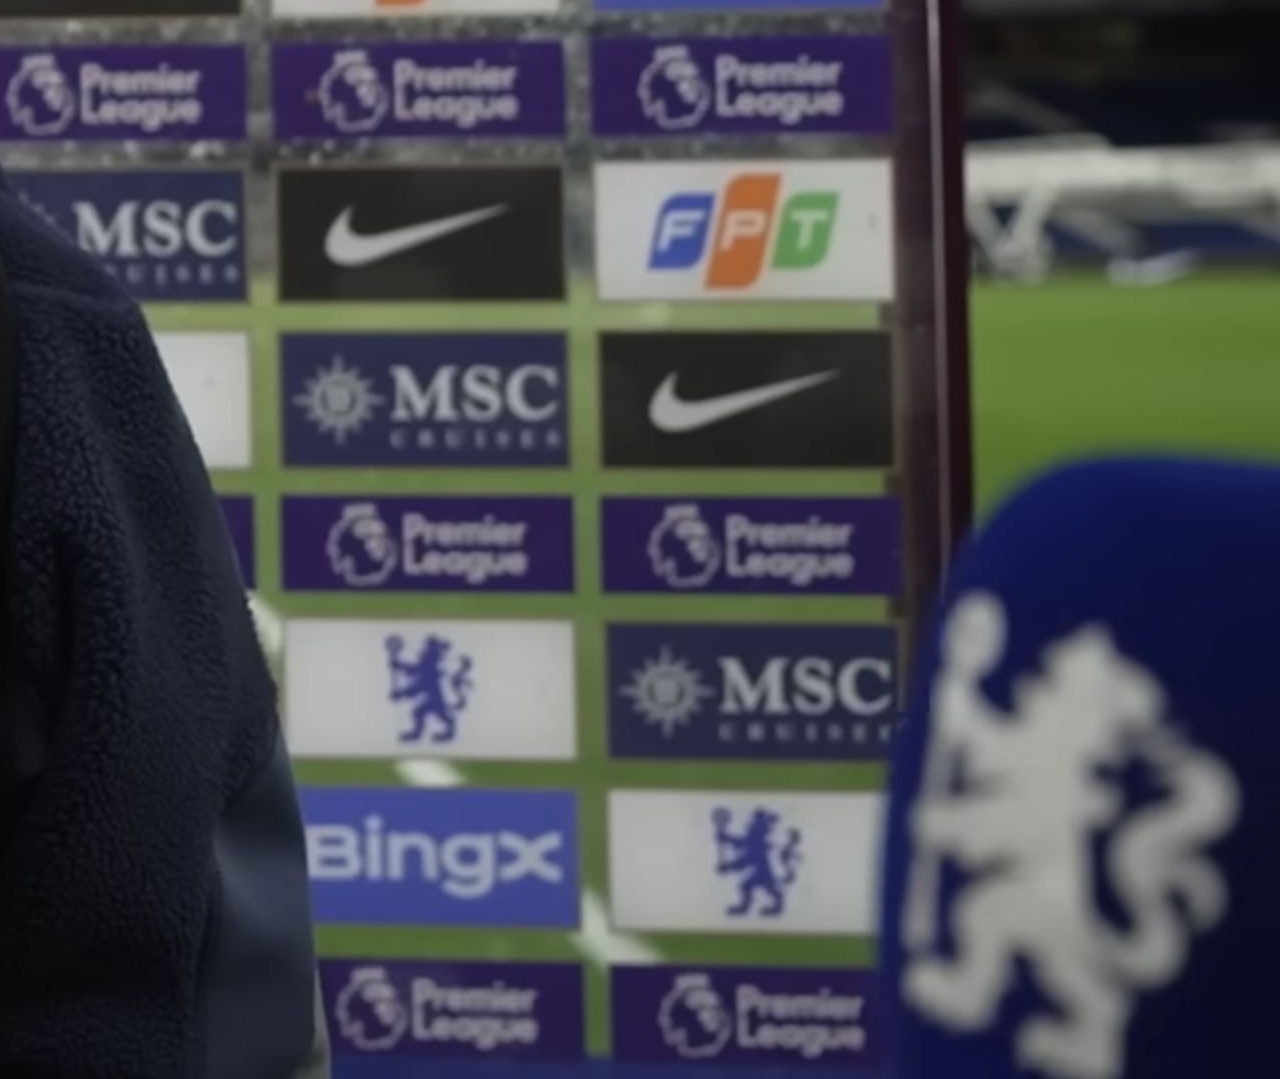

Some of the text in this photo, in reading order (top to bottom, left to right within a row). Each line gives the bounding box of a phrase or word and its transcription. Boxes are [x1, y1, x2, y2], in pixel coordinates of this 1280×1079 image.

[80, 62, 199, 98] Premier
[393, 58, 516, 94] Premier
[715, 53, 841, 90] Premier
[80, 96, 201, 132] League
[393, 92, 518, 127] League
[715, 88, 843, 125] League
[72, 198, 238, 259] MSC
[390, 364, 558, 422] MSC
[403, 513, 525, 549] Premier
[726, 514, 851, 550] Premier
[403, 547, 527, 584] League
[726, 548, 853, 586] League
[718, 655, 891, 716] MSC
[411, 977, 535, 1016] Premier
[736, 984, 863, 1023] Premier
[411, 1012, 538, 1051] League
[736, 1019, 865, 1059] League
